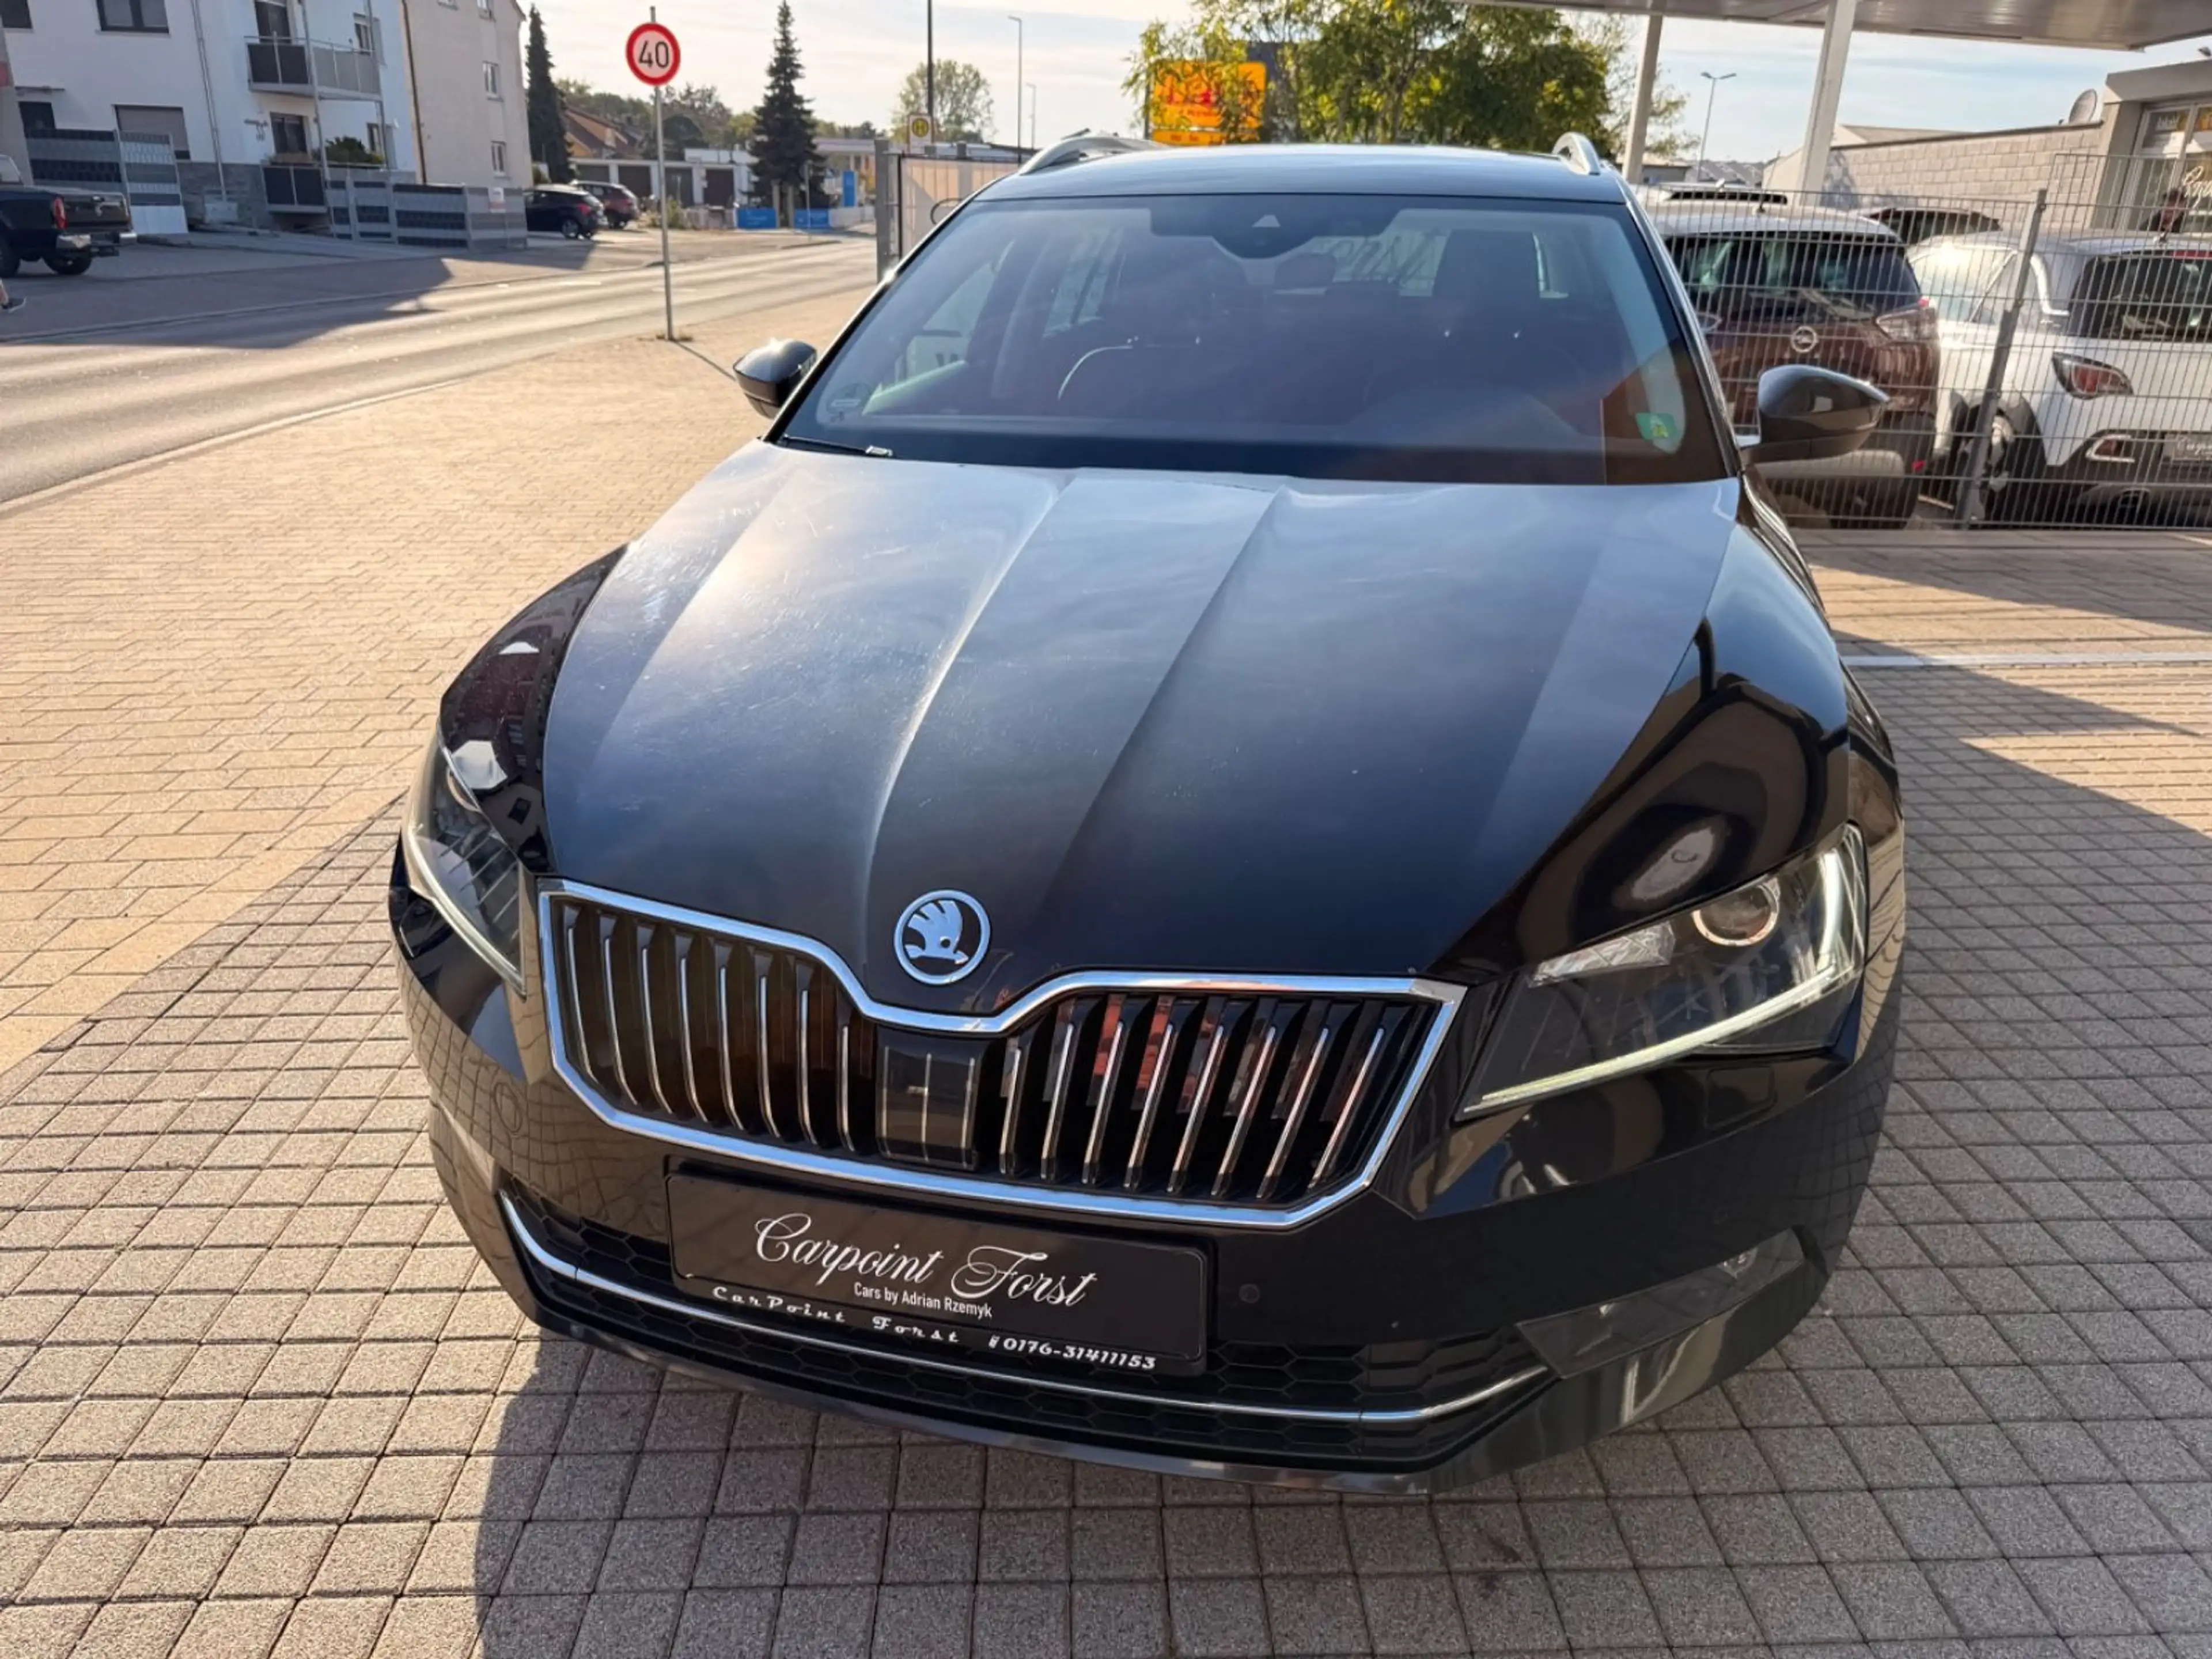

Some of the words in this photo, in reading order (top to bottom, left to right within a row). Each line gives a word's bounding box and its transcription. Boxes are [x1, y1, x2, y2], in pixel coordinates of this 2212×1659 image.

[639, 40, 670, 69] 40
[755, 1213, 944, 1286] Carpoint
[951, 1245, 1097, 1306] Forst
[711, 1286, 846, 1323] CarPoint
[872, 1316, 960, 1343] Forst
[1003, 1338, 1157, 1370] 0176-31411153
[854, 1281, 881, 1300] Cars
[884, 1286, 898, 1305] by
[902, 1290, 941, 1310] Adrian
[944, 1296, 992, 1321] Rzemyk
